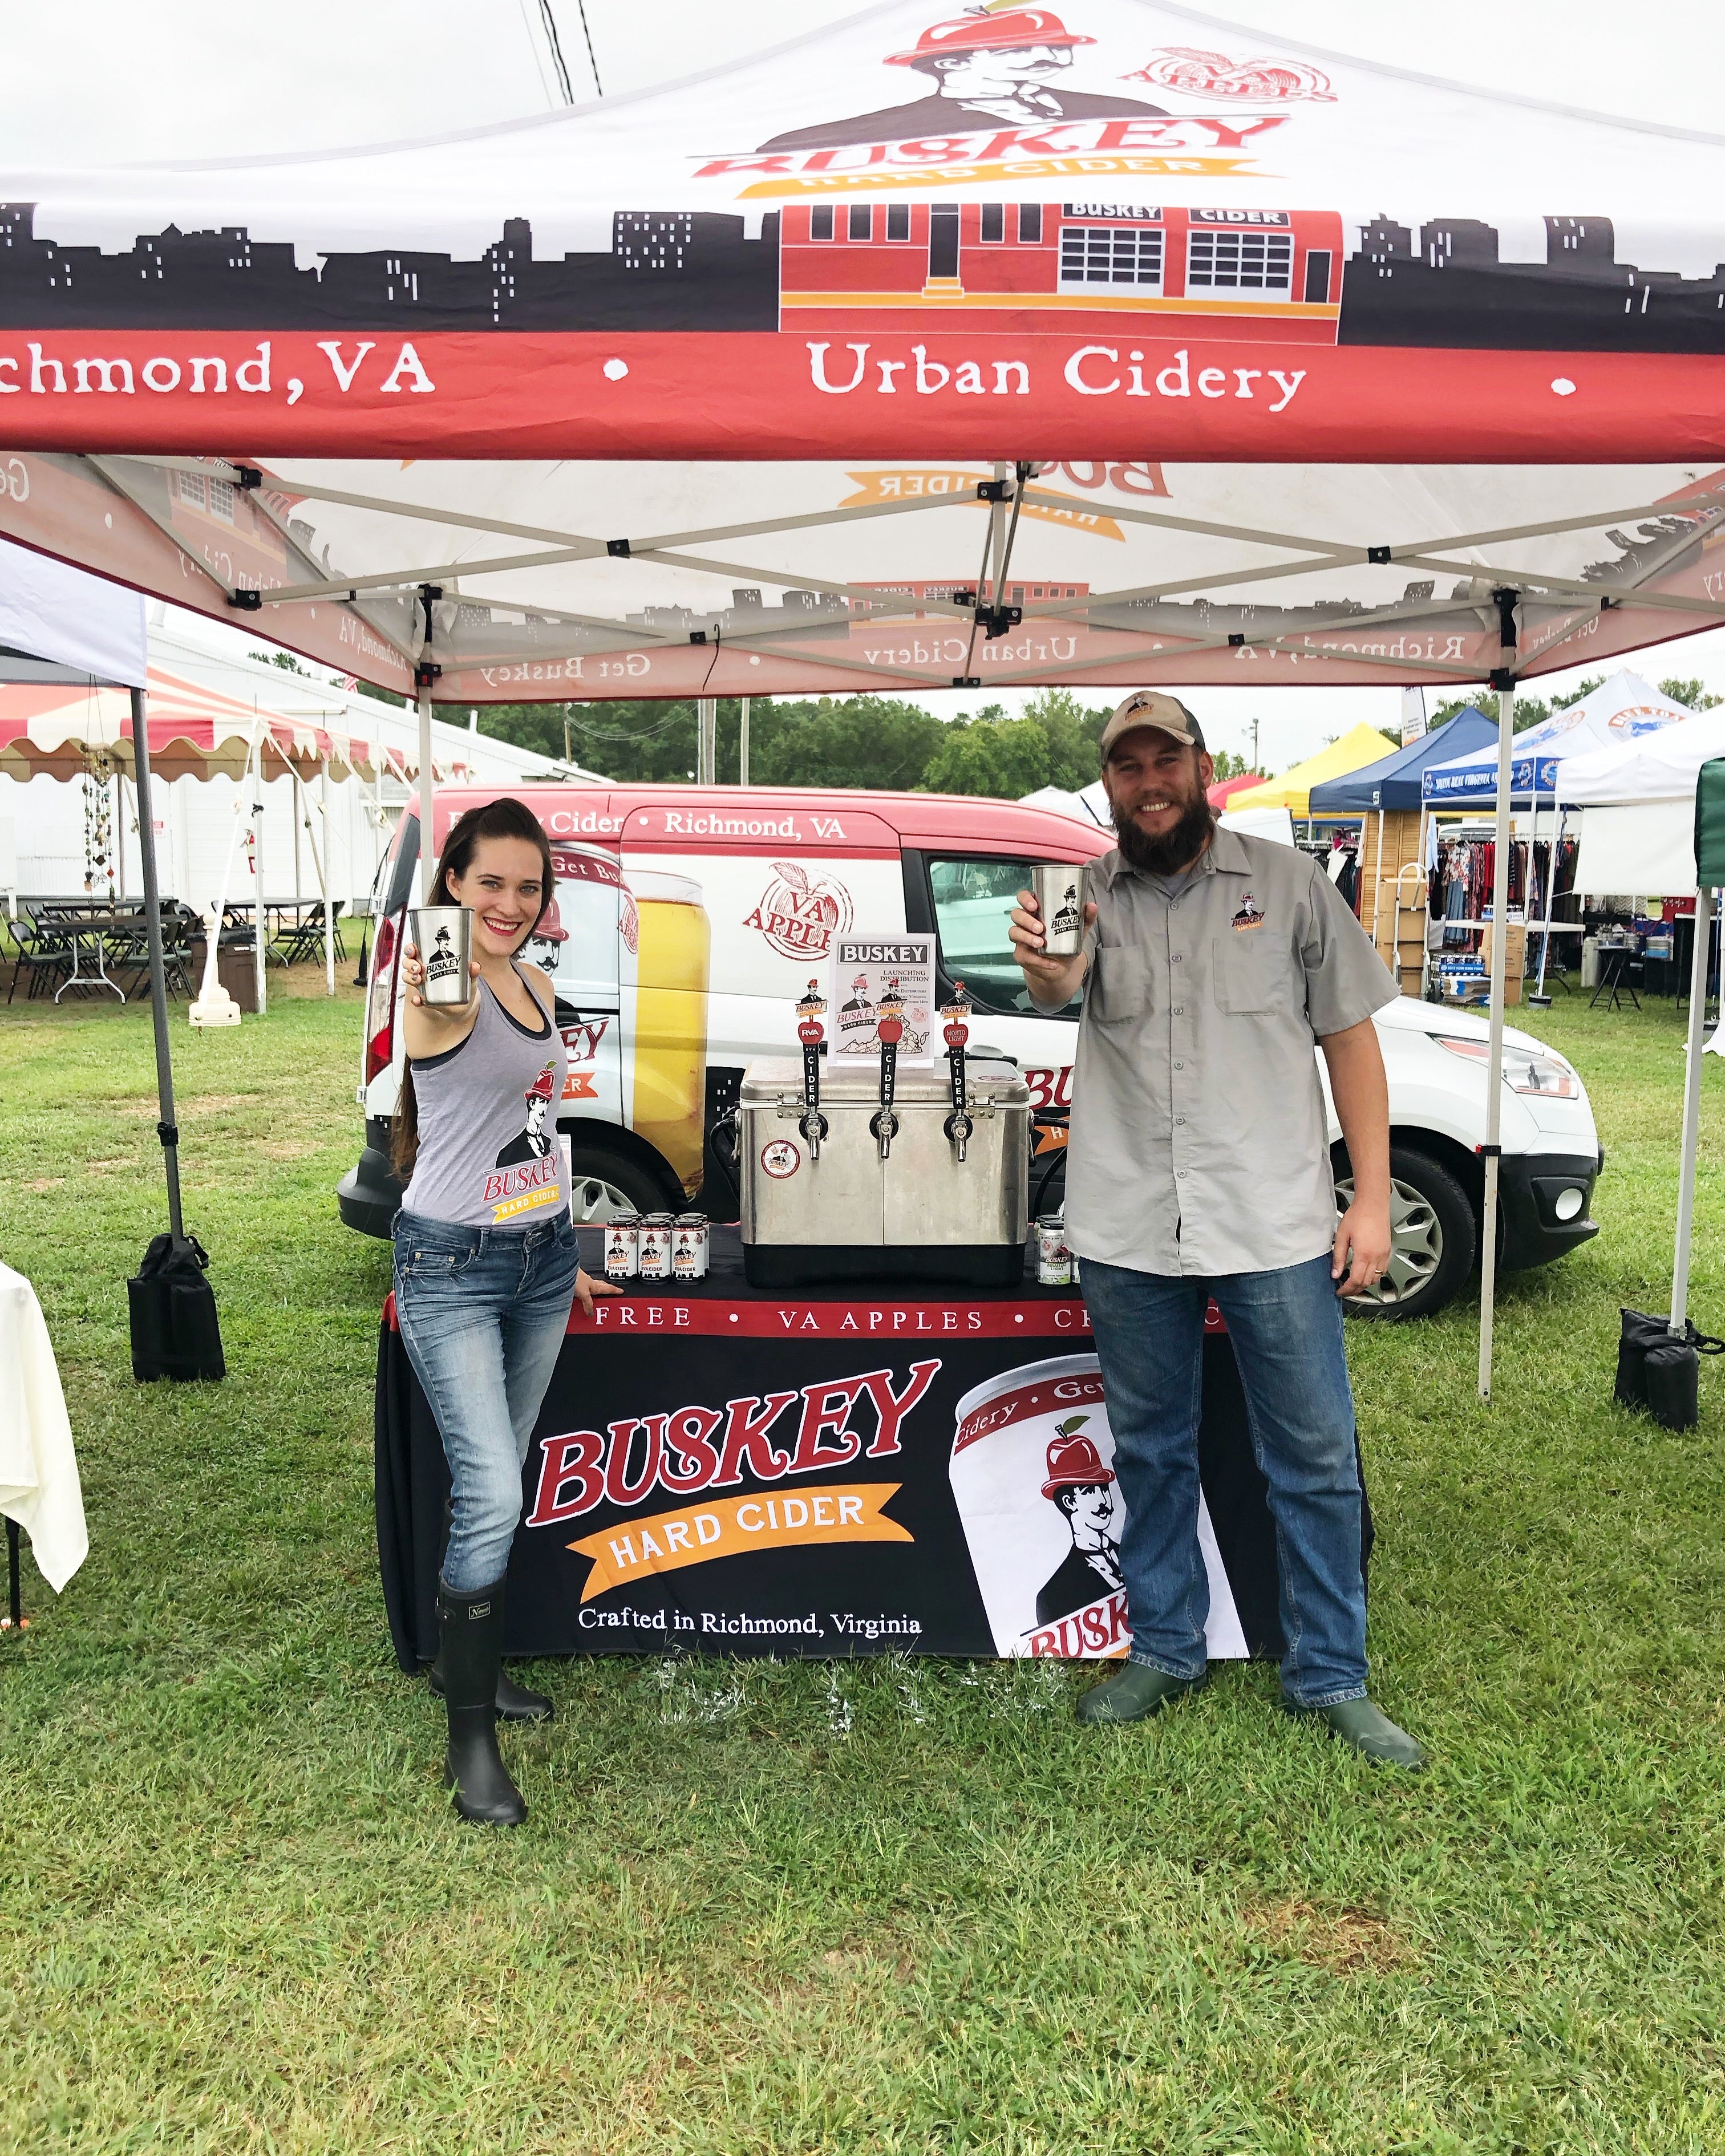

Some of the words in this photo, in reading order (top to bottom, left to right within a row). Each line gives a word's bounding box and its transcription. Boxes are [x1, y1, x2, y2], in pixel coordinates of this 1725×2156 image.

[1003, 159, 1207, 173] CIDER
[1072, 203, 1160, 219] BUSKEY
[1199, 209, 1282, 224] CIDER
[0, 342, 303, 405] chmond,
[317, 342, 436, 393] VA
[807, 343, 1030, 395] Urban
[1064, 346, 1306, 412] Cidery
[551, 812, 625, 833] Cider
[665, 812, 803, 841] Richmond,
[810, 818, 847, 838] VA
[550, 857, 588, 875] Get
[789, 891, 826, 923] VA
[742, 908, 831, 951] APPLE
[1051, 915, 1082, 929] BUSKEY
[427, 957, 461, 974] BUSKEY
[844, 946, 924, 962] BUSKEY
[796, 1002, 824, 1012] BUSKEY
[837, 1008, 876, 1023] BUSKEY
[876, 1000, 906, 1011] BUSKEY
[941, 1006, 970, 1014] BUSKEY
[954, 1059, 962, 1104] CIDER
[481, 1154, 558, 1202] BUSKEY
[501, 1198, 529, 1214] HARD
[533, 1190, 556, 1203] CIDER
[606, 1251, 629, 1261] BUSKEY
[640, 1251, 663, 1262] BUSKEY
[673, 1252, 696, 1262] BUSKEY
[596, 1307, 690, 1326] FREE
[778, 1311, 820, 1330] VA
[840, 1311, 982, 1330] APPLES
[955, 1401, 1019, 1444] Cidery
[526, 1359, 942, 1527] BUSKEY
[608, 1514, 720, 1568] HARD
[736, 1496, 864, 1533] CIDER
[578, 1609, 666, 1630] Crafted
[674, 1610, 695, 1630] in
[702, 1614, 824, 1638] Richmond,
[830, 1614, 922, 1635] Virginia
[1029, 1591, 1134, 1658] BUSK
